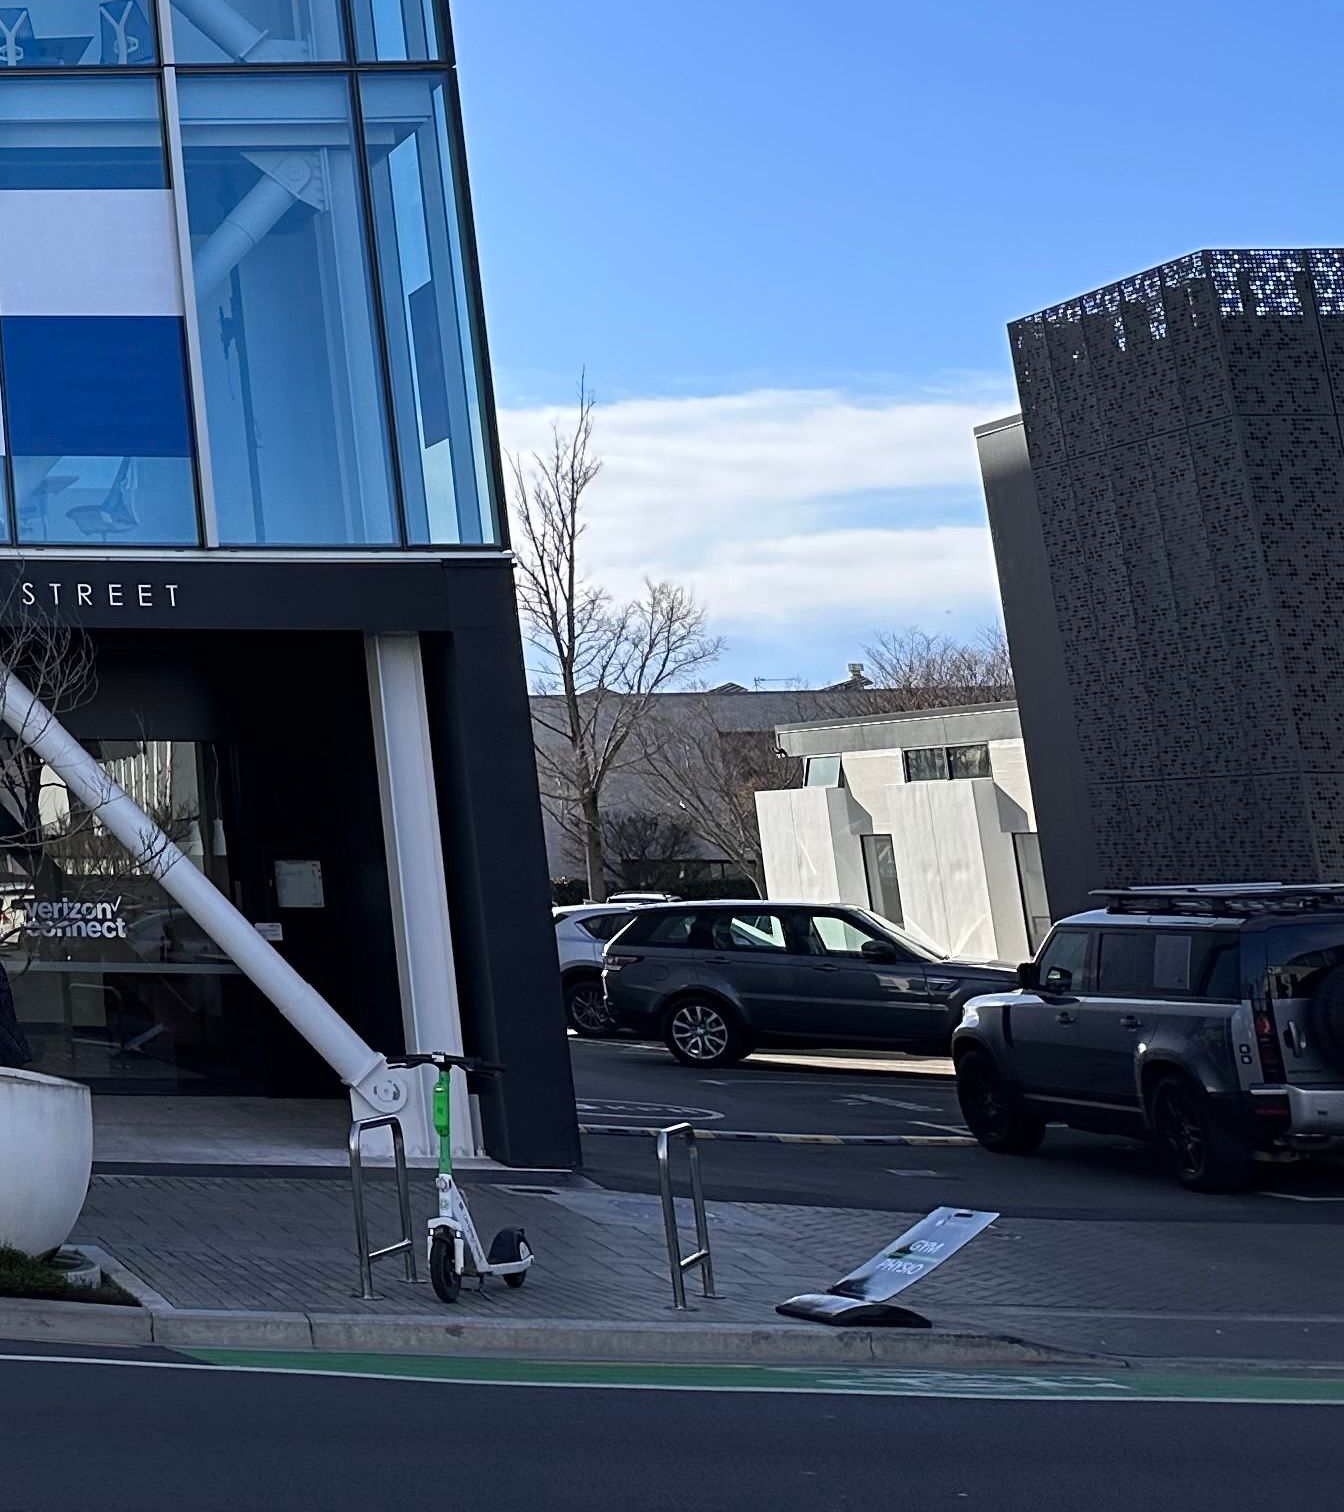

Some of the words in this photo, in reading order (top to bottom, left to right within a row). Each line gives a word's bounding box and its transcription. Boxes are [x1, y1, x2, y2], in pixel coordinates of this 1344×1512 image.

[22, 582, 179, 607] STREET
[24, 897, 113, 919] verizon
[25, 918, 127, 938] connect
[909, 1239, 945, 1254] GYM
[876, 1258, 925, 1275] PHYSIO
